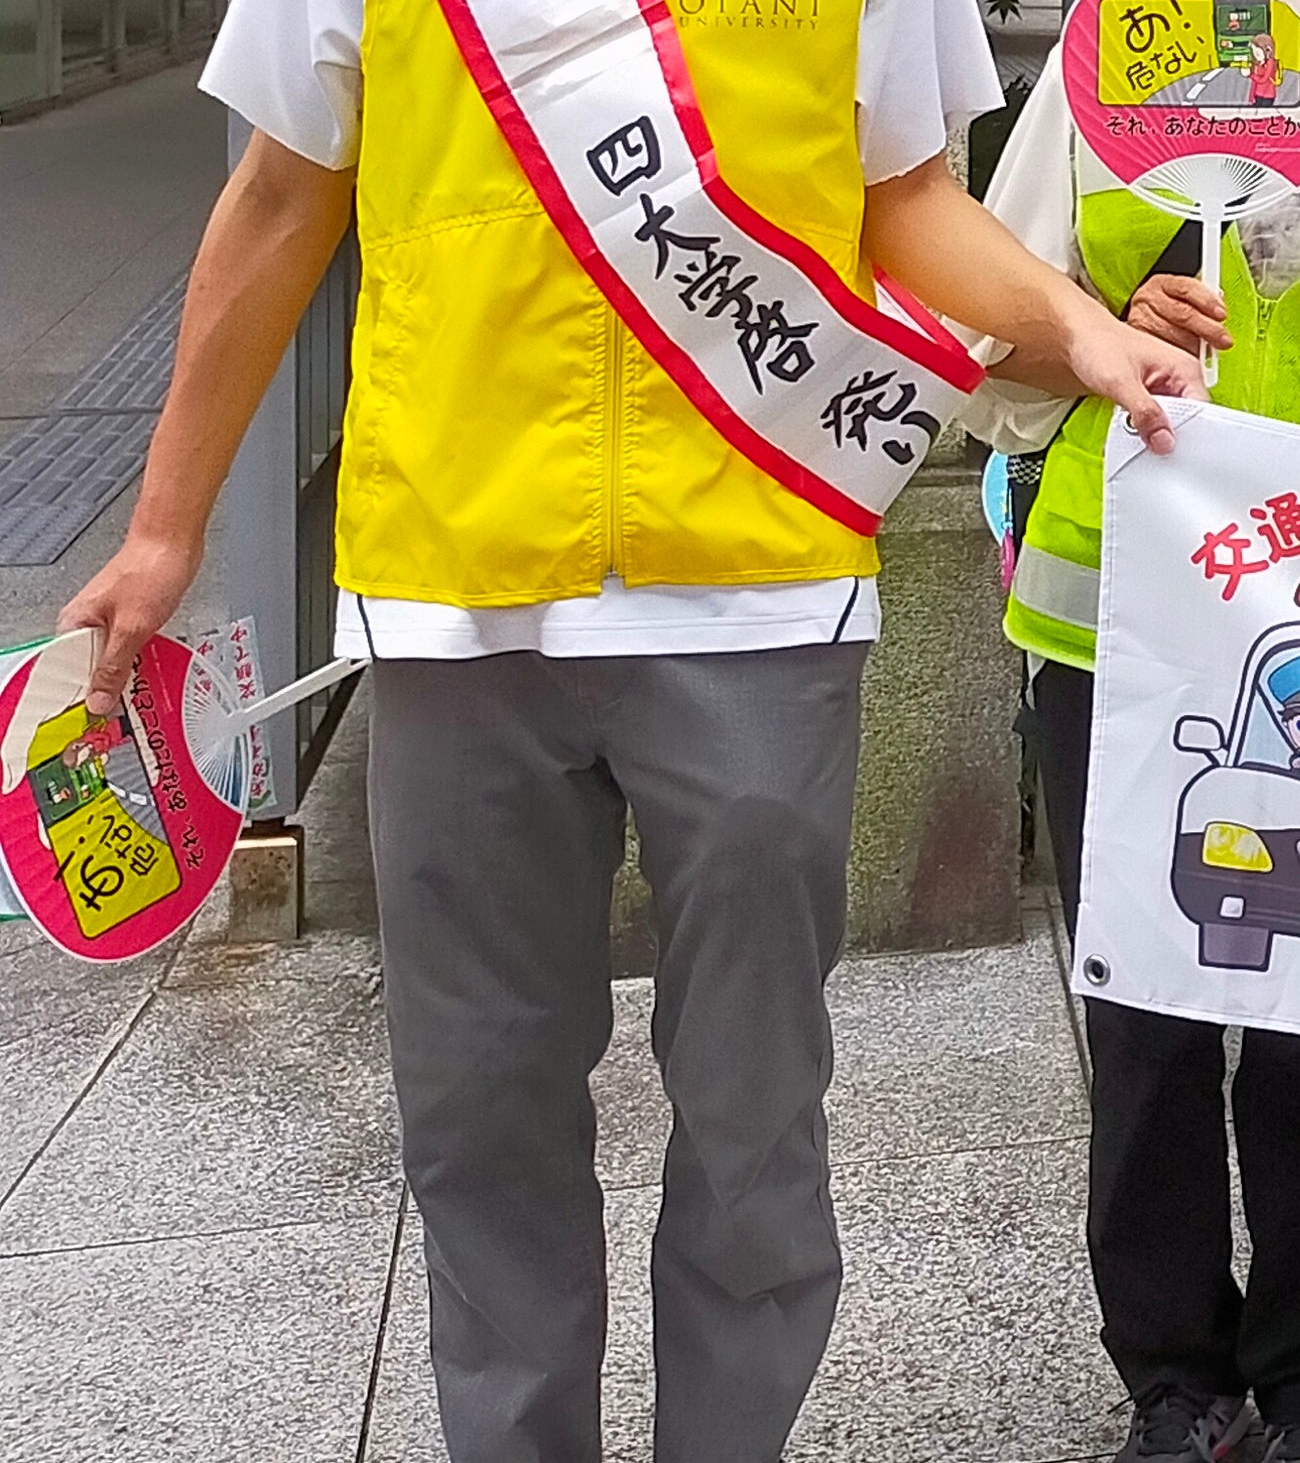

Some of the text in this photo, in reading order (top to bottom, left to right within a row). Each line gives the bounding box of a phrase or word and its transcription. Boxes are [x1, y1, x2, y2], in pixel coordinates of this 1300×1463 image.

[679, 16, 820, 30] UNIVERSITY
[1126, 36, 1205, 90] 危ない
[87, 815, 158, 877] 危ない
